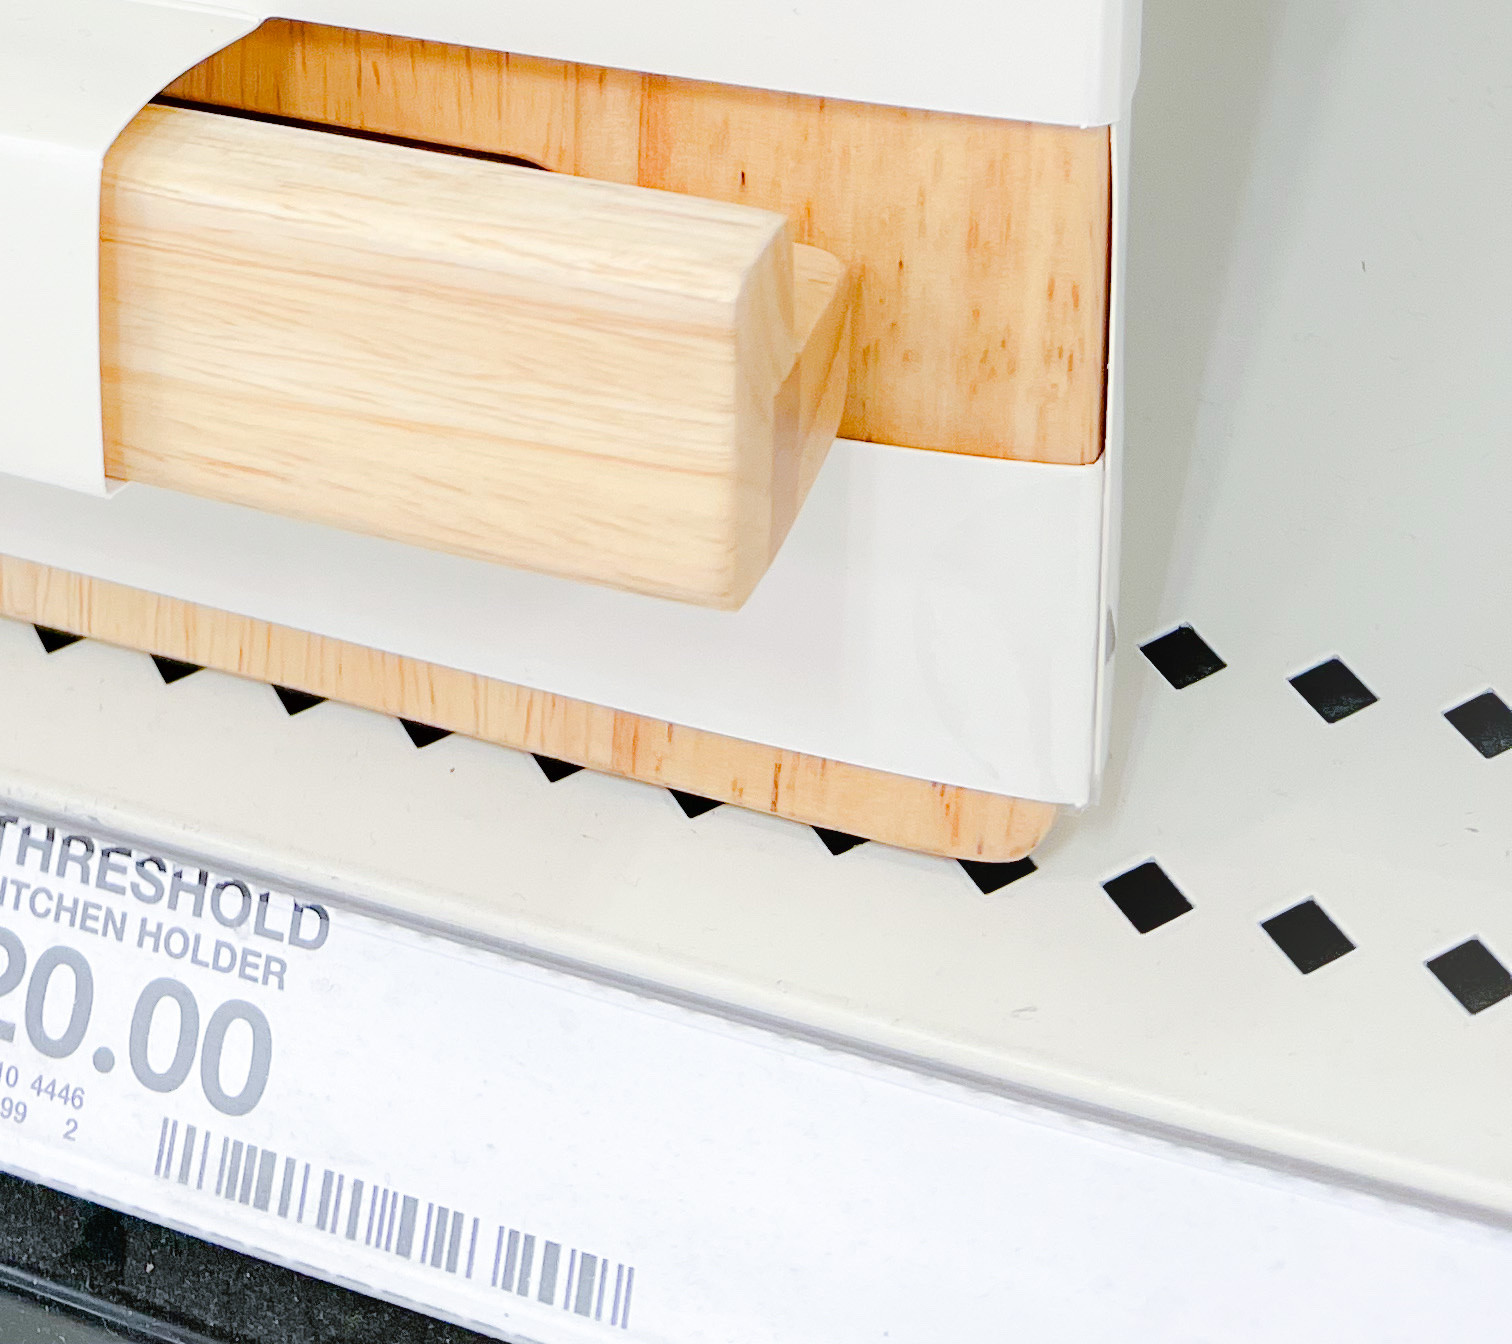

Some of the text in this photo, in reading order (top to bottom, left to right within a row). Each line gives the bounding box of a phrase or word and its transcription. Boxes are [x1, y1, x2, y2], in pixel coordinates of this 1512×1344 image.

[137, 916, 287, 991] HOLDER
[30, 1074, 85, 1110] 4446
[63, 1119, 79, 1142] 2
